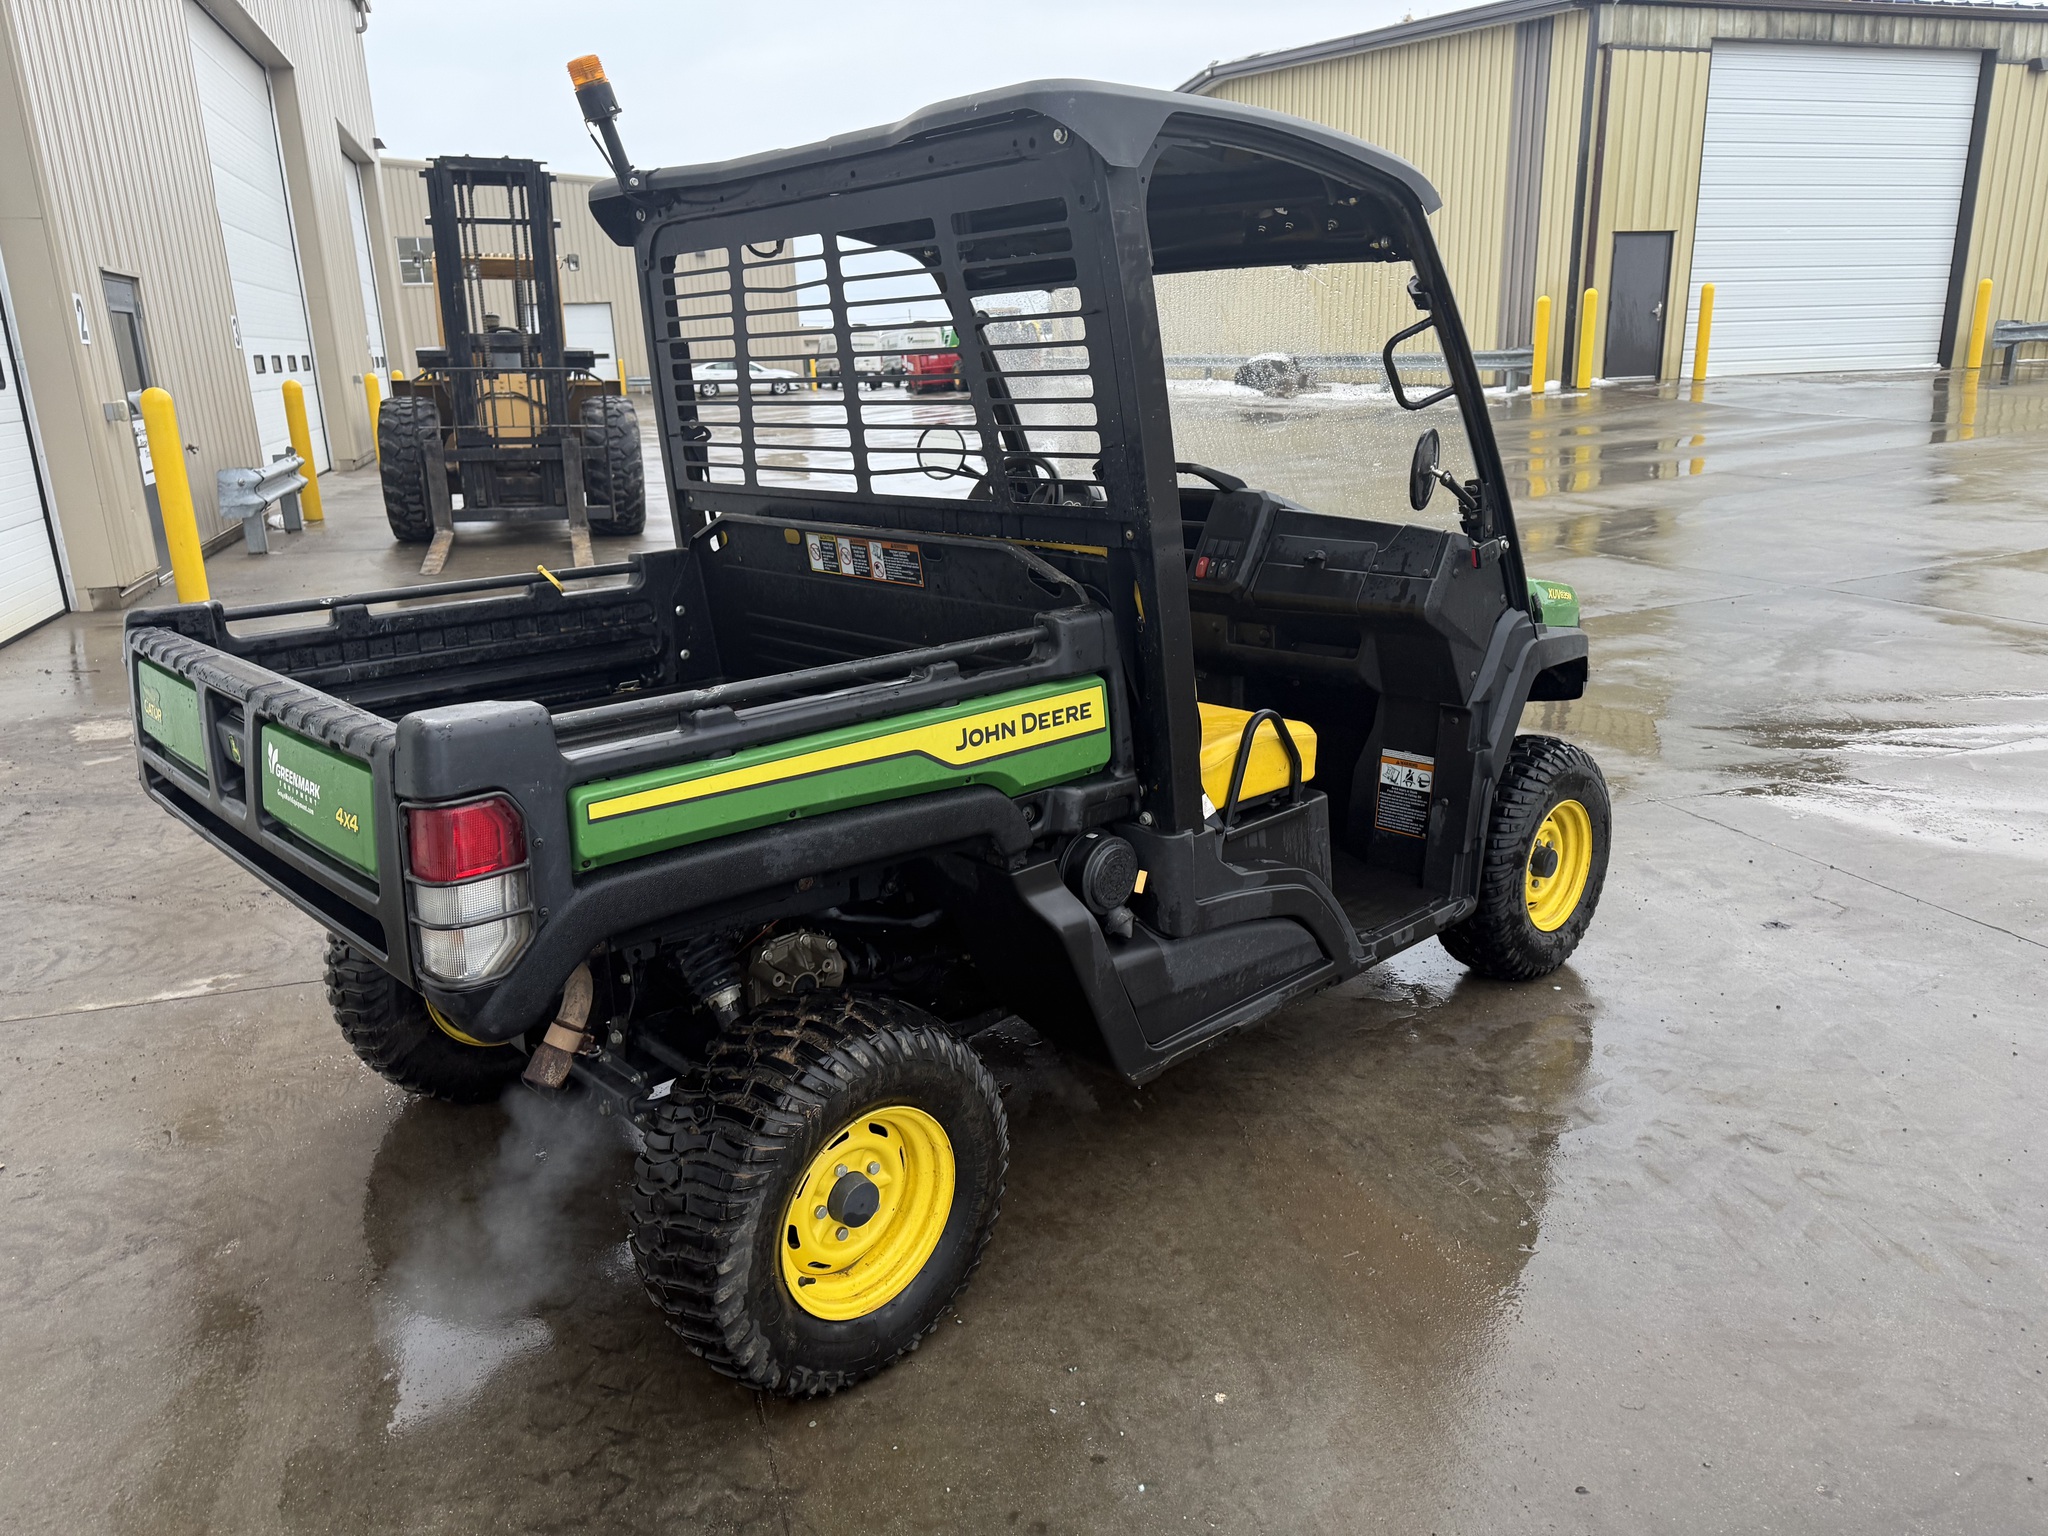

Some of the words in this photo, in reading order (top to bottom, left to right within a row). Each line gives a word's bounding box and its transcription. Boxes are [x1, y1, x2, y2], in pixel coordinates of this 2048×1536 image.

[75, 298, 89, 340] 2
[232, 318, 241, 346] 3
[144, 699, 162, 723] GATOR
[956, 719, 1016, 752] JOHN
[1021, 702, 1092, 735] DEERE
[275, 763, 320, 800] GREENMARK
